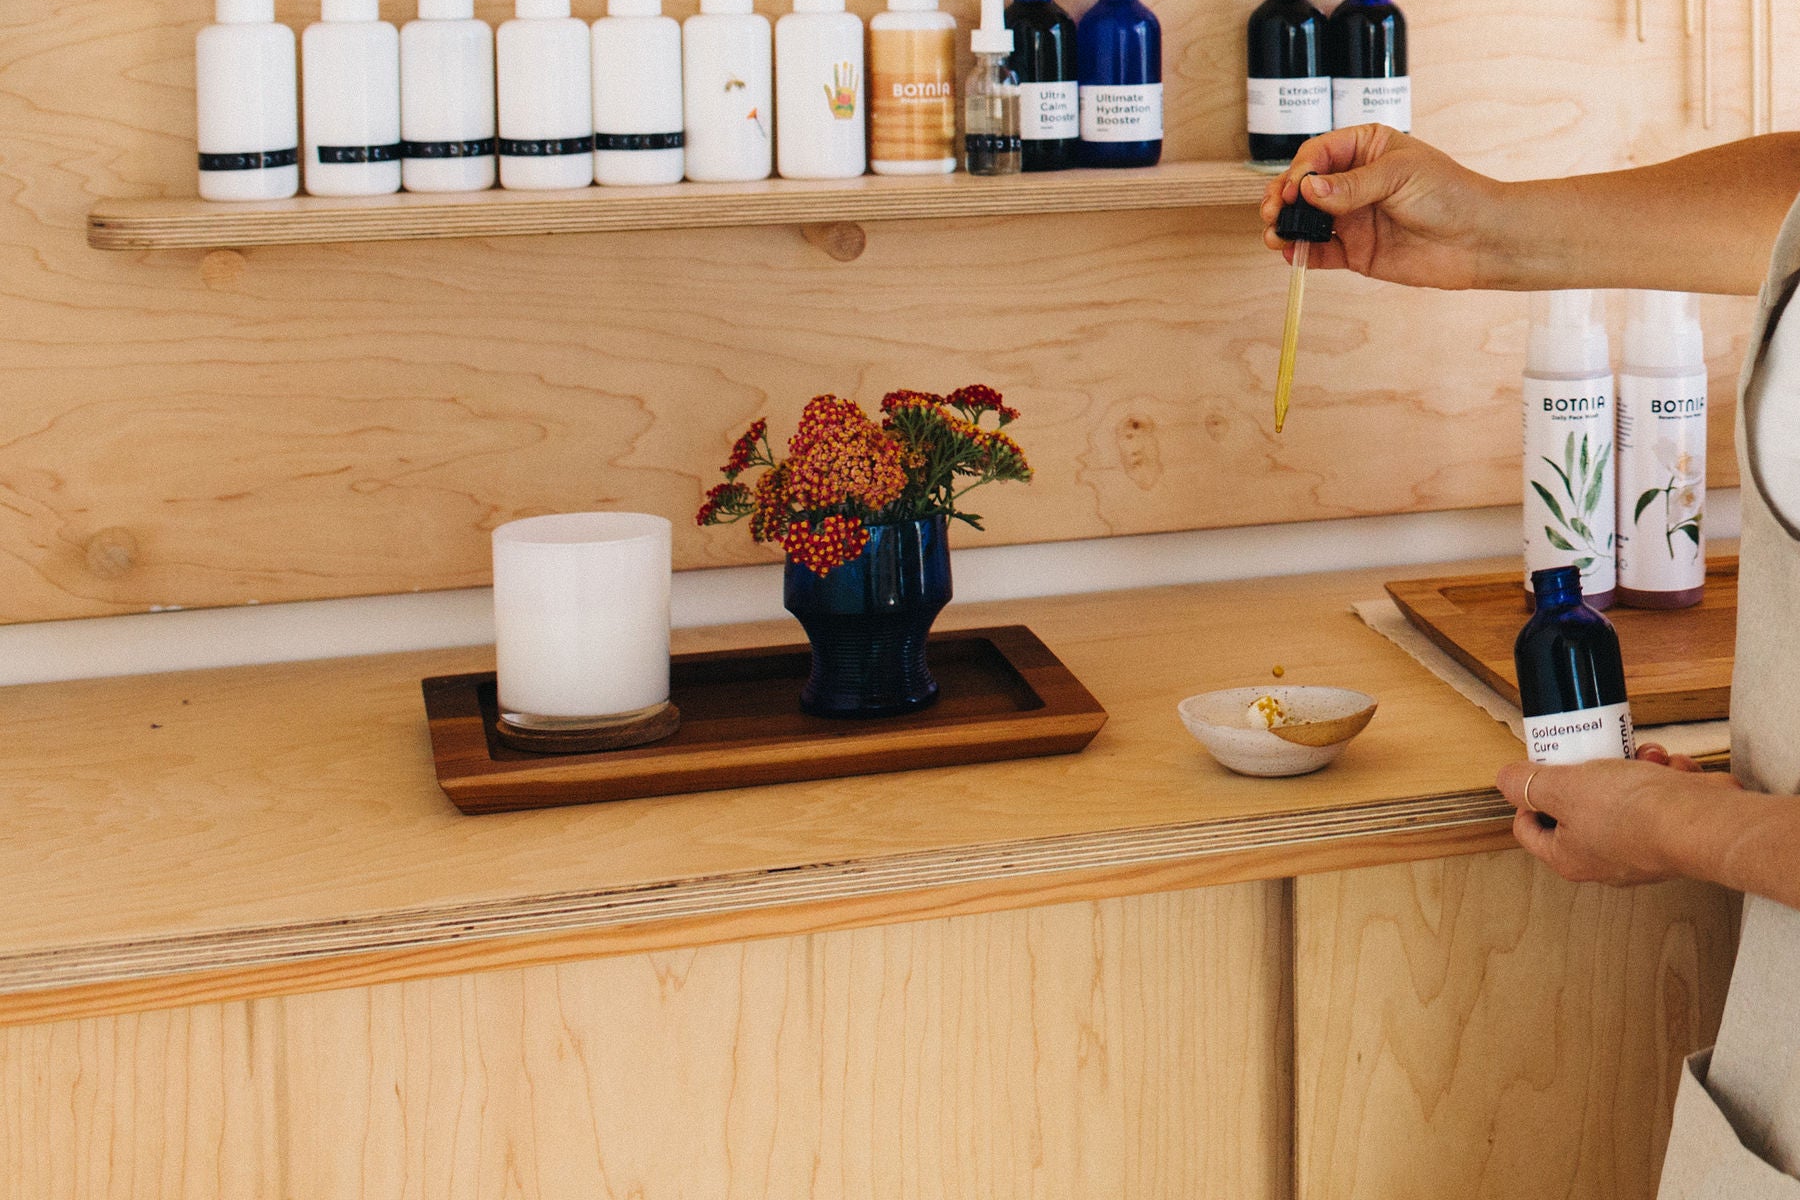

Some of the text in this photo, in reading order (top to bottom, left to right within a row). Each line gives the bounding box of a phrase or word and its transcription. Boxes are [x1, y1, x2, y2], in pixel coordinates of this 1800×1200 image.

[892, 82, 950, 97] BOTNIA
[1040, 91, 1066, 100] Ultra
[1096, 94, 1144, 103] Ultimate
[1279, 97, 1320, 106] Booster
[1362, 97, 1402, 106] Booster
[1040, 102, 1067, 111] Calm
[1096, 104, 1151, 115] Hydration
[1096, 116, 1141, 125] Booster
[1543, 395, 1605, 412] BOTNIA
[1532, 718, 1603, 739] Goldenseal
[1533, 741, 1559, 753] Cure
